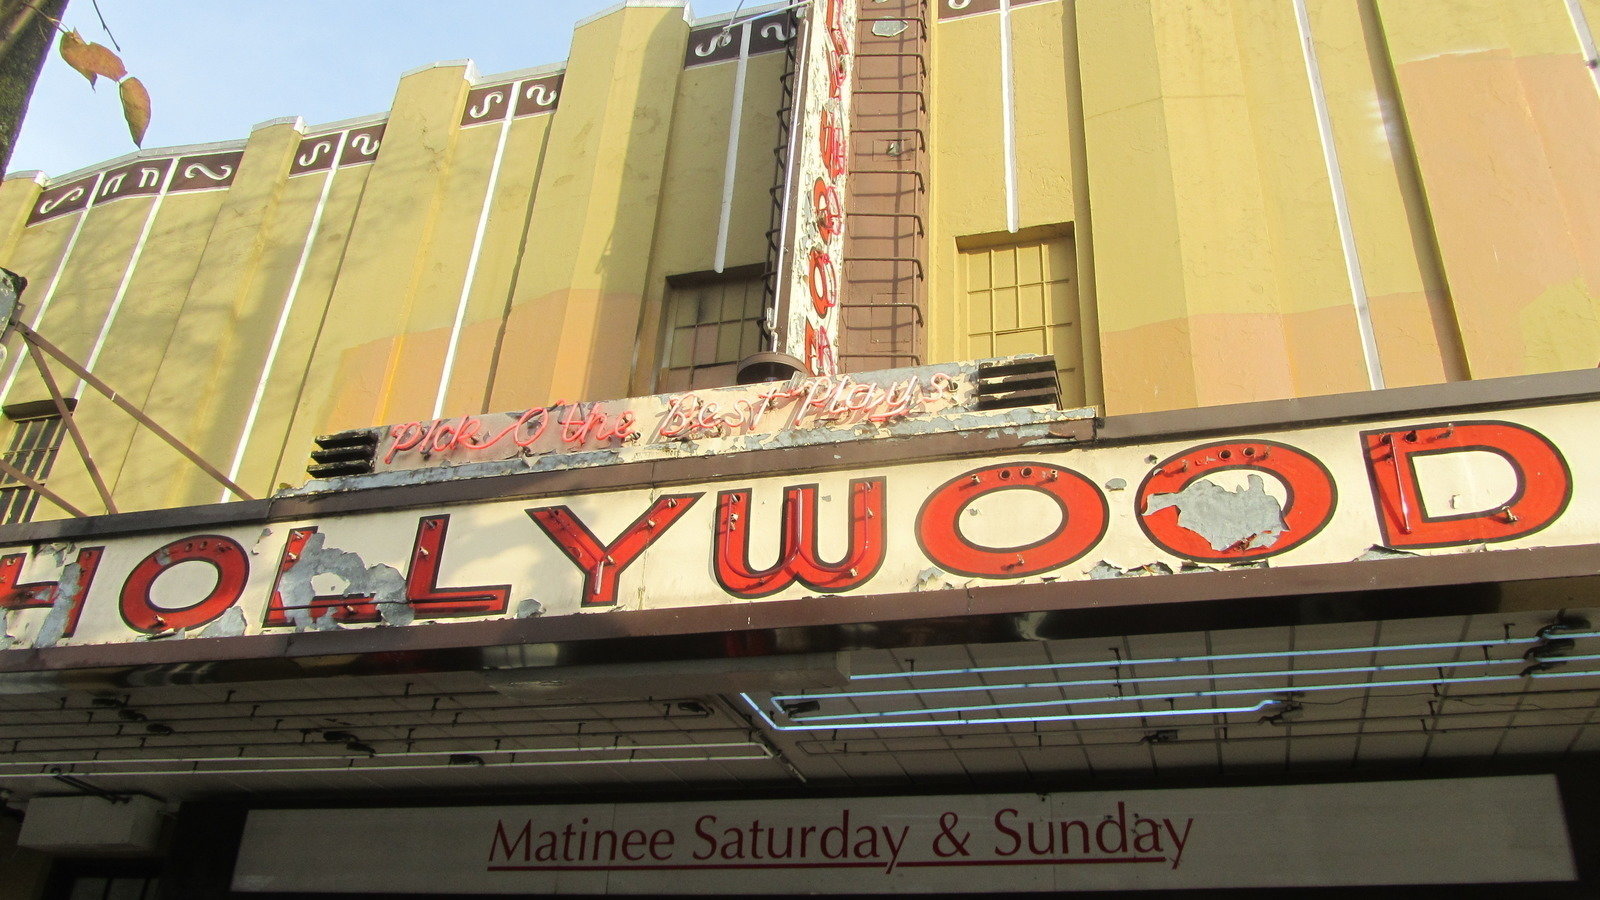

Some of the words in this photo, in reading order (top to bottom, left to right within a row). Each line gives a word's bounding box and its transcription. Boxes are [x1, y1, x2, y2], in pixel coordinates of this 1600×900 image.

[0, 419, 1574, 641] HOLLYWOOD
[488, 817, 675, 863] Matinee
[692, 809, 910, 874] Saturday
[932, 811, 971, 858] &
[995, 801, 1194, 870] Sunday
